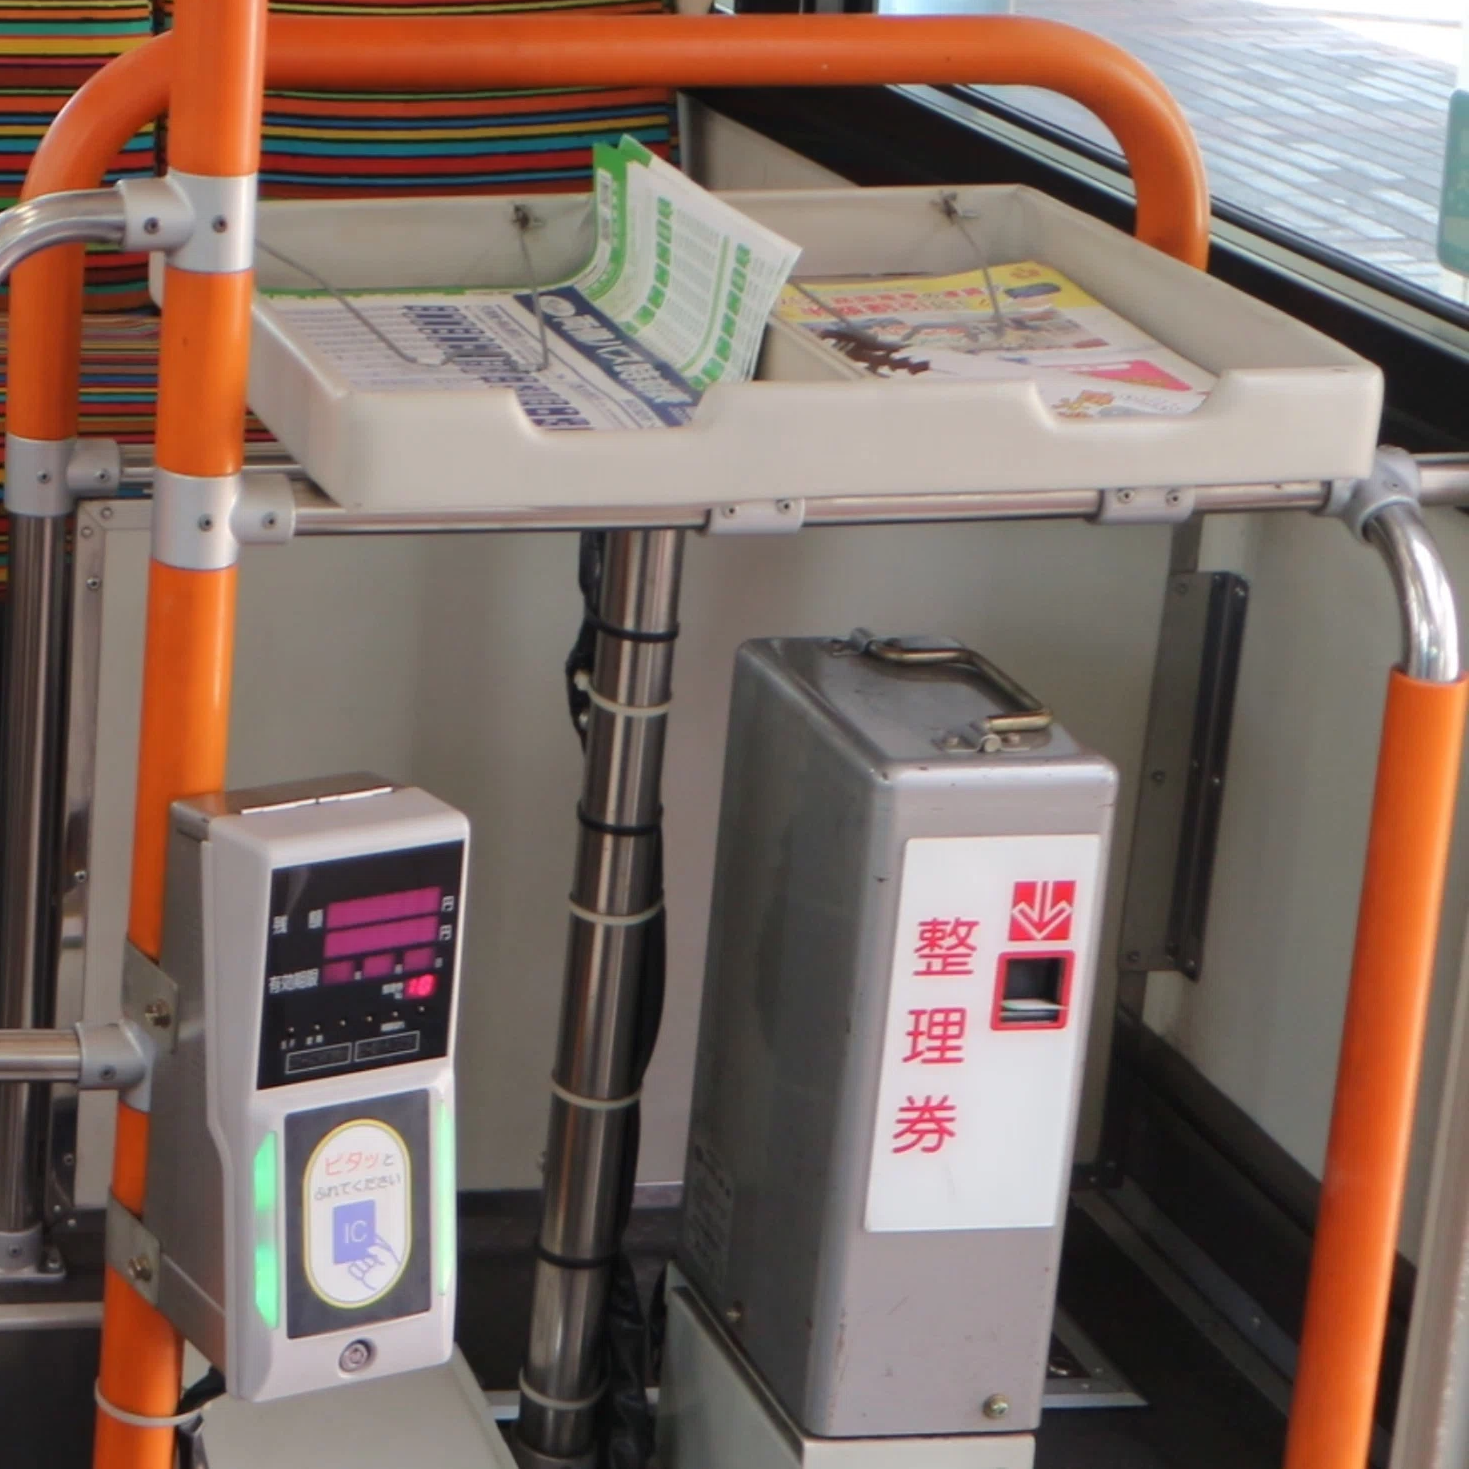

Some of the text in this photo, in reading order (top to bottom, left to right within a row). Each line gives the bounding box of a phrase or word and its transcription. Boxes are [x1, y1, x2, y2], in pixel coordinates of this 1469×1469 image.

[891, 916, 979, 1155] 整理券
[314, 1172, 401, 1202] ふれてください
[343, 1219, 367, 1245] IC
